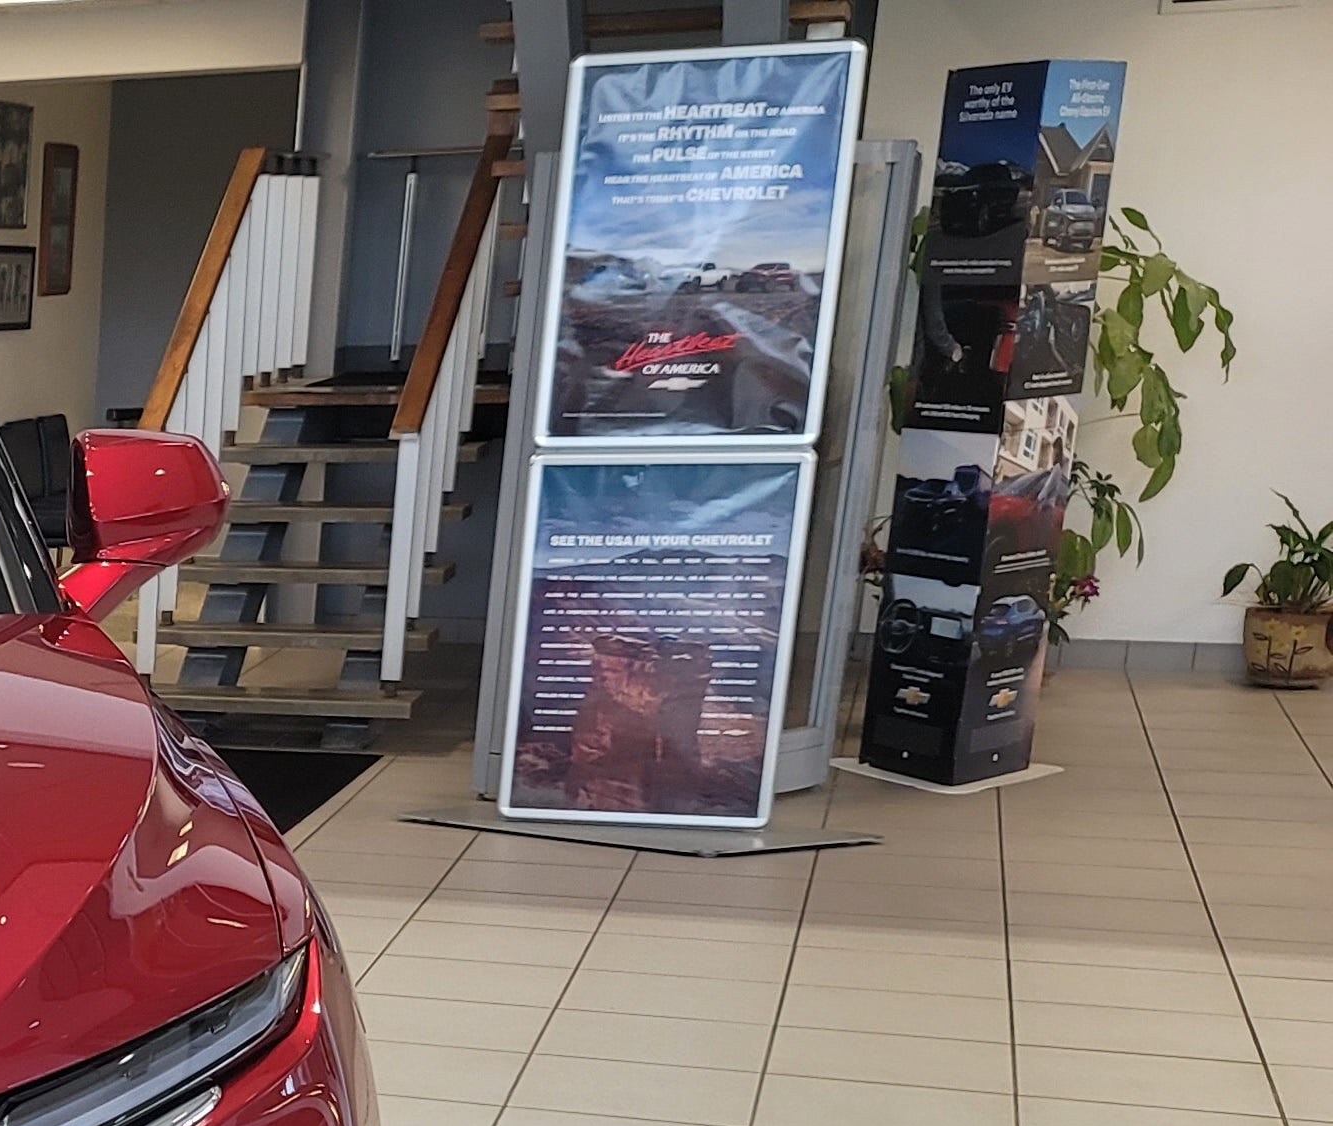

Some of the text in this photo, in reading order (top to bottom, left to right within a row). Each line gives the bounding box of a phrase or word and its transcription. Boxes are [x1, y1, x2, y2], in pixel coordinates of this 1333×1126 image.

[663, 102, 768, 120] HEARTBEAT
[779, 105, 827, 116] AMERICA
[656, 123, 734, 141] RHYTHM
[652, 145, 708, 161] PULSE
[720, 164, 804, 180] AMERICA
[685, 185, 789, 202] CHEVROLET
[647, 332, 673, 344] THE
[642, 363, 720, 375] OF AMERICA
[549, 533, 774, 547] SEE THE USA IN YOUR CHEVROLET
